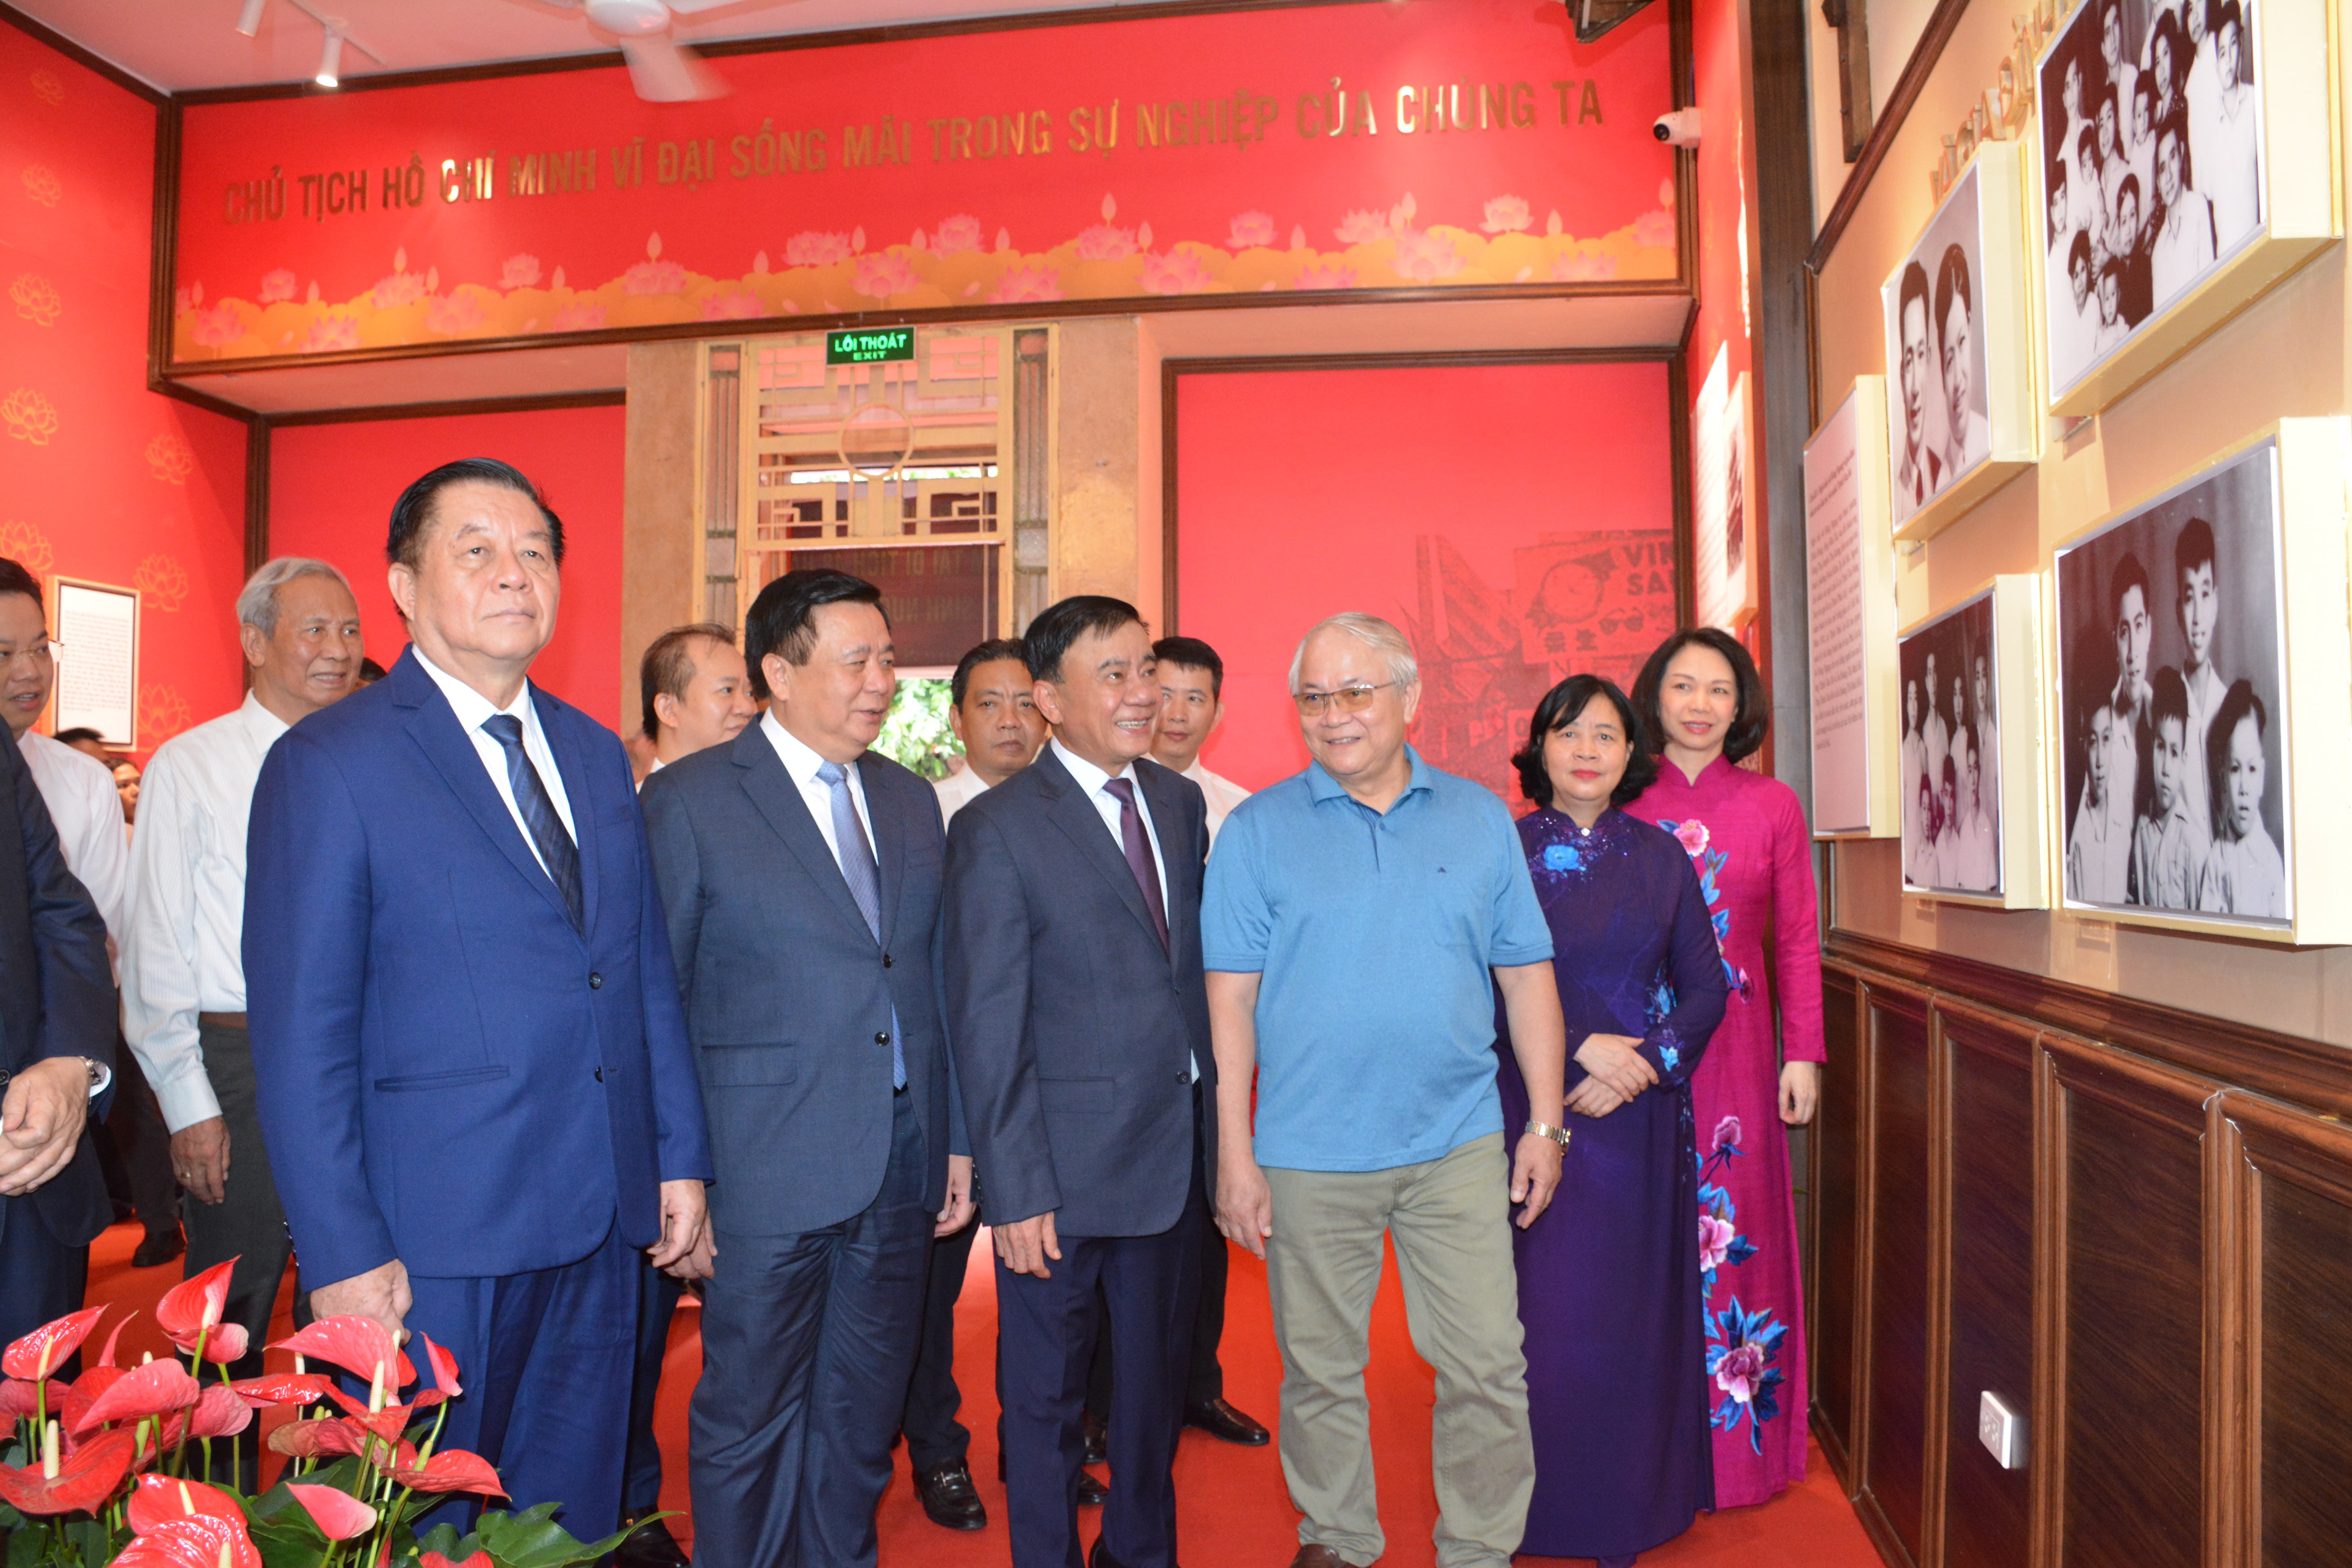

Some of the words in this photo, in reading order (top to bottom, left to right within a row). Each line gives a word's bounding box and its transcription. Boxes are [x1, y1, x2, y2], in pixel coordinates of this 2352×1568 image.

[224, 165, 287, 224] CHỦ
[298, 169, 368, 224] TỊCH
[382, 150, 425, 209] HỒ
[439, 149, 496, 203] CHÍ
[509, 148, 595, 198] MINH
[610, 136, 645, 189] VĨ
[657, 138, 715, 191] ĐẠI
[730, 117, 827, 179] SỐNG
[842, 114, 911, 169] MÃI
[926, 109, 1052, 162] TRONG
[1067, 98, 1119, 160] SỰ
[1137, 88, 1278, 152] NGHIỆP
[1296, 76, 1377, 139] CỦA
[1396, 76, 1534, 133] CHÚNG
[1551, 79, 1603, 127] TA
[859, 332, 907, 350] THOÁT
[853, 351, 887, 361] EXIT
